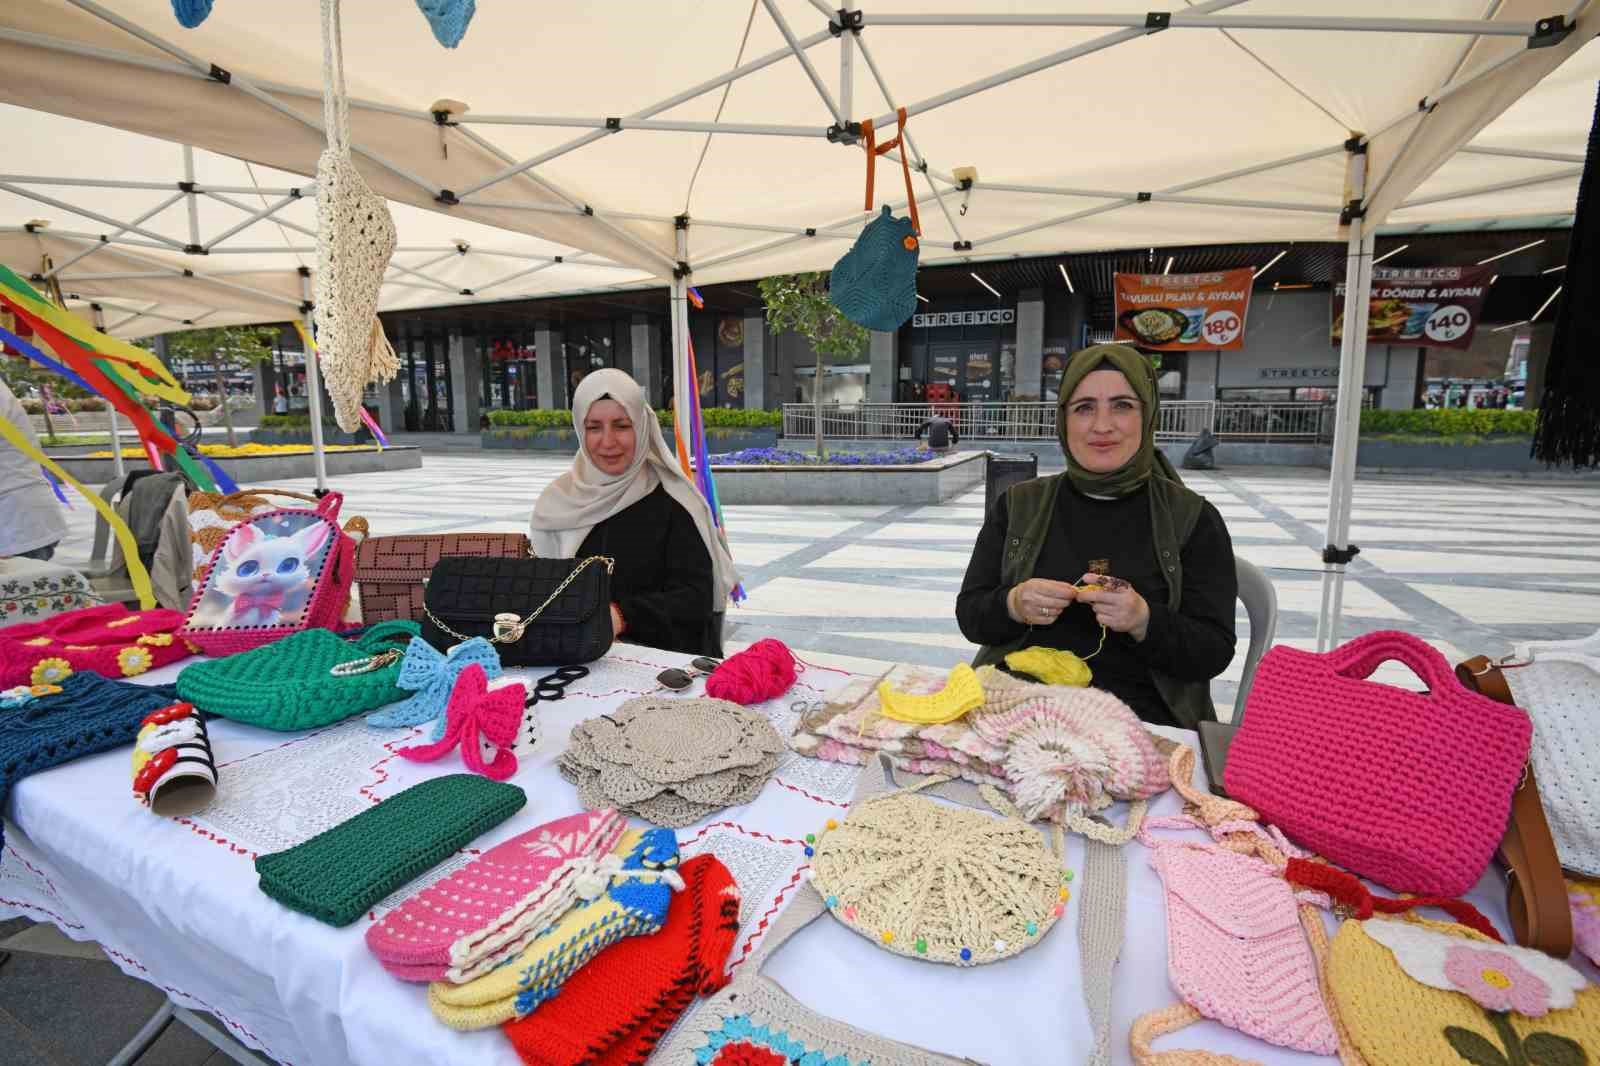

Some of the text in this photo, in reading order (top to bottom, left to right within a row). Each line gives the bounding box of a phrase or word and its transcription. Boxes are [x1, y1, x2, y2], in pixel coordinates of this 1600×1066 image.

[1208, 290, 1245, 300] AYRAN
[1382, 286, 1425, 298] DÖNER
[1427, 288, 1437, 298] &
[1439, 287, 1482, 298] AYRAN
[913, 310, 1014, 327] STREETCO
[1205, 316, 1239, 335] 180
[1428, 312, 1467, 331] 140
